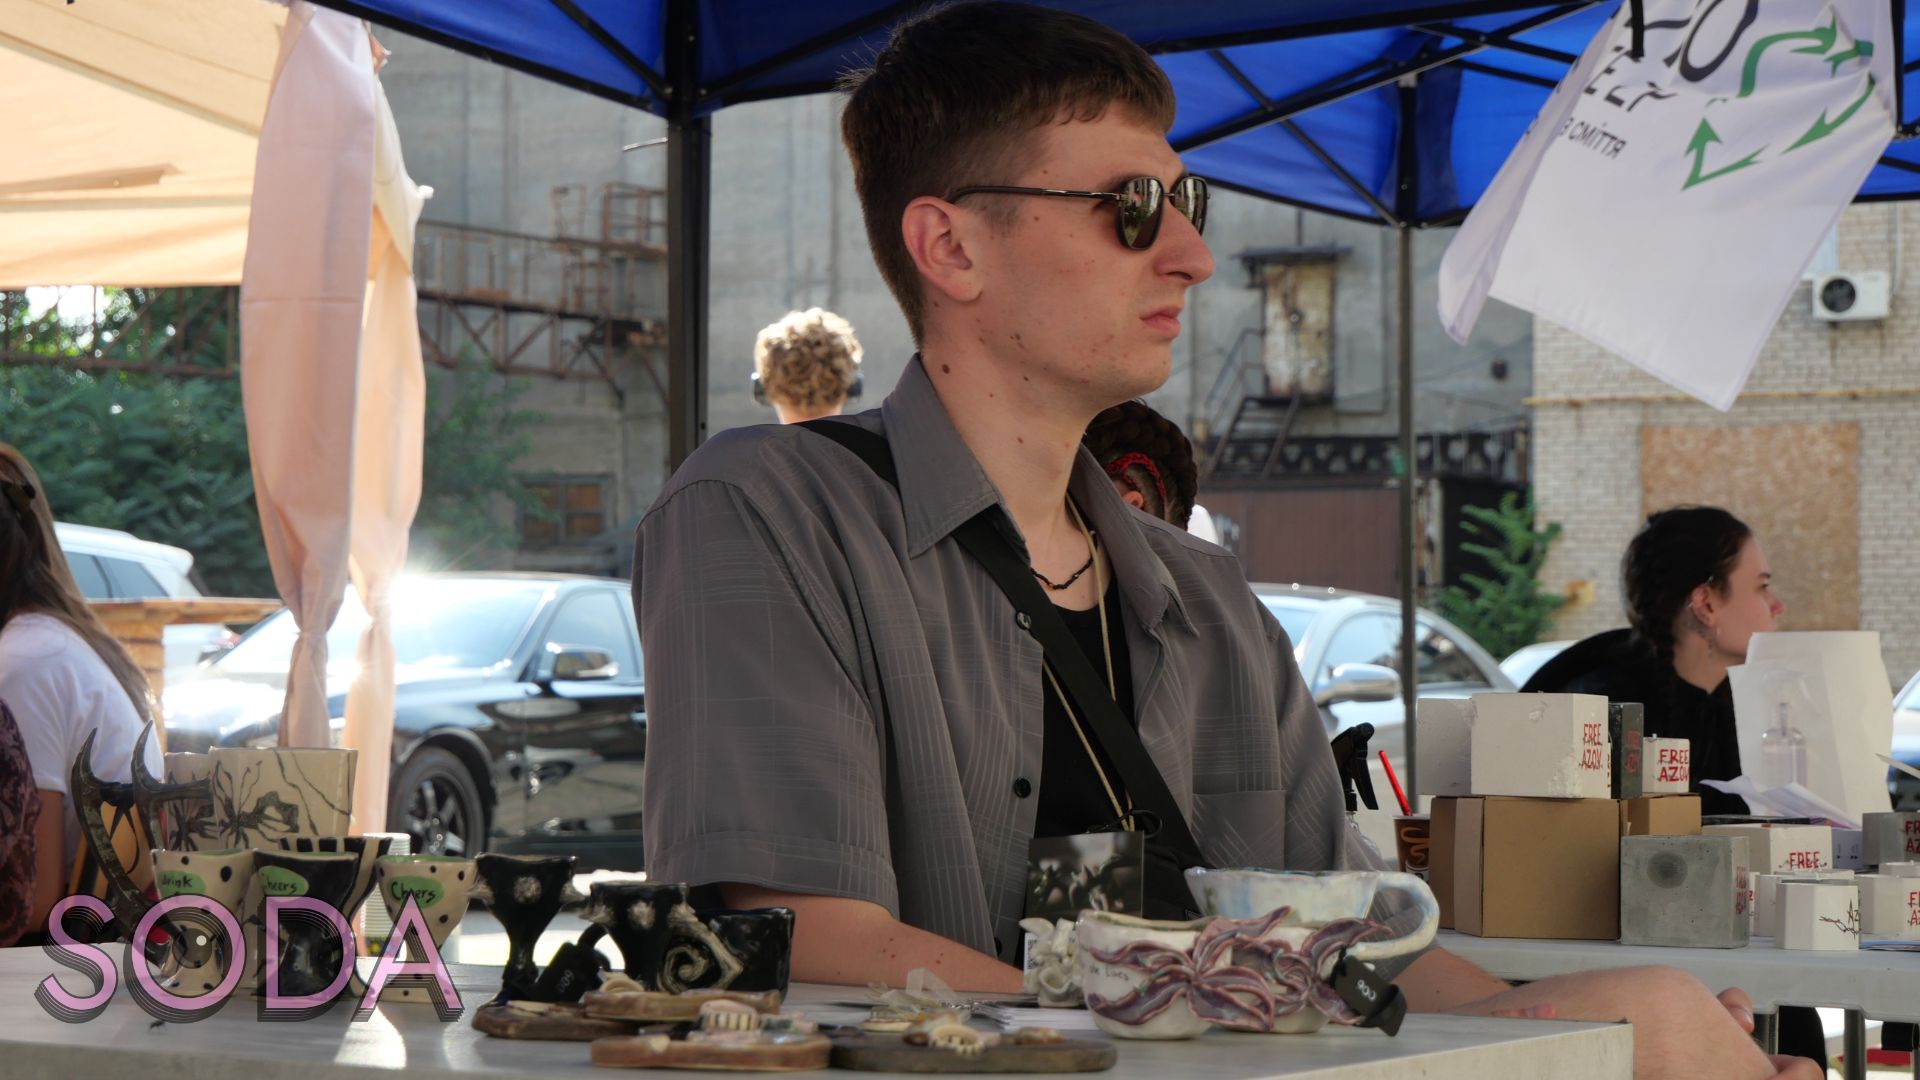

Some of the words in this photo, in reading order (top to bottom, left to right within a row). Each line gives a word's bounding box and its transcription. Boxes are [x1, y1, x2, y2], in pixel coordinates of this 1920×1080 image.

[1583, 723, 1602, 746] FREE
[1658, 748, 1689, 765] FREE
[1788, 851, 1821, 872] FREE
